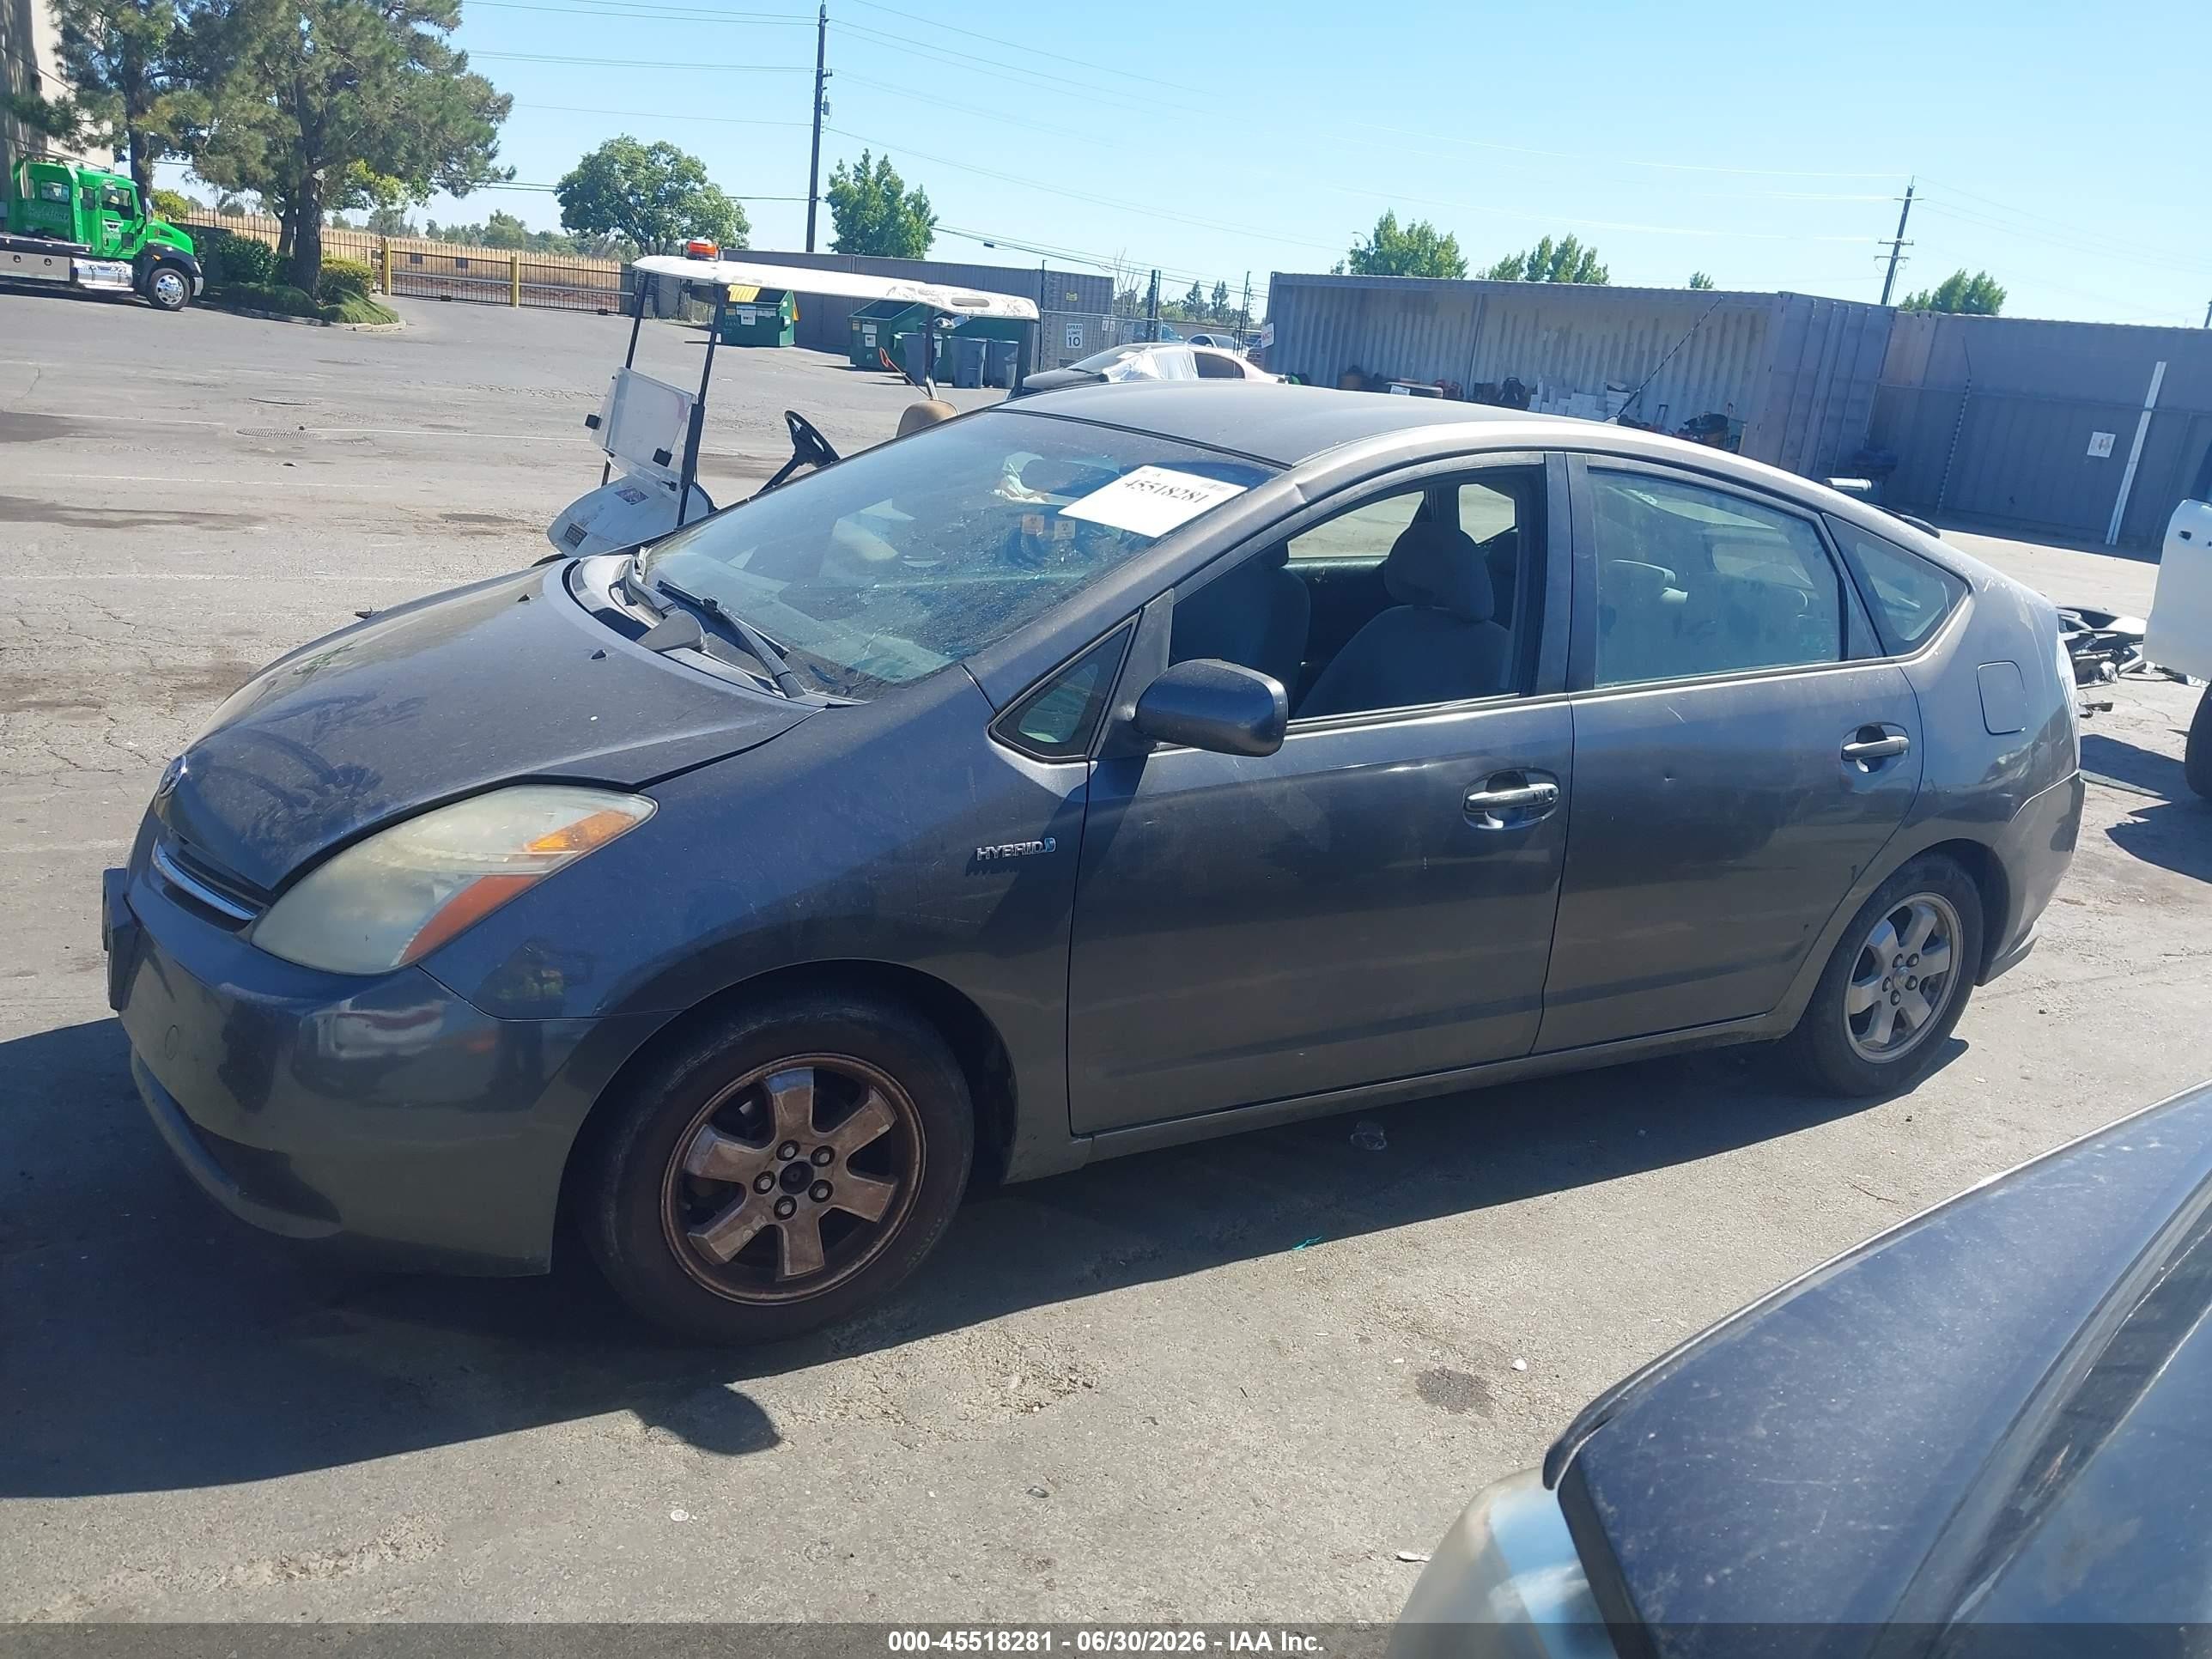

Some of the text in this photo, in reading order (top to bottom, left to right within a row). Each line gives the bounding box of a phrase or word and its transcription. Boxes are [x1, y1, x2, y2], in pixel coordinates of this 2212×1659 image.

[1068, 337, 1081, 347] 10
[1124, 479, 1210, 503] 45518281
[976, 841, 1044, 861] HYBRID
